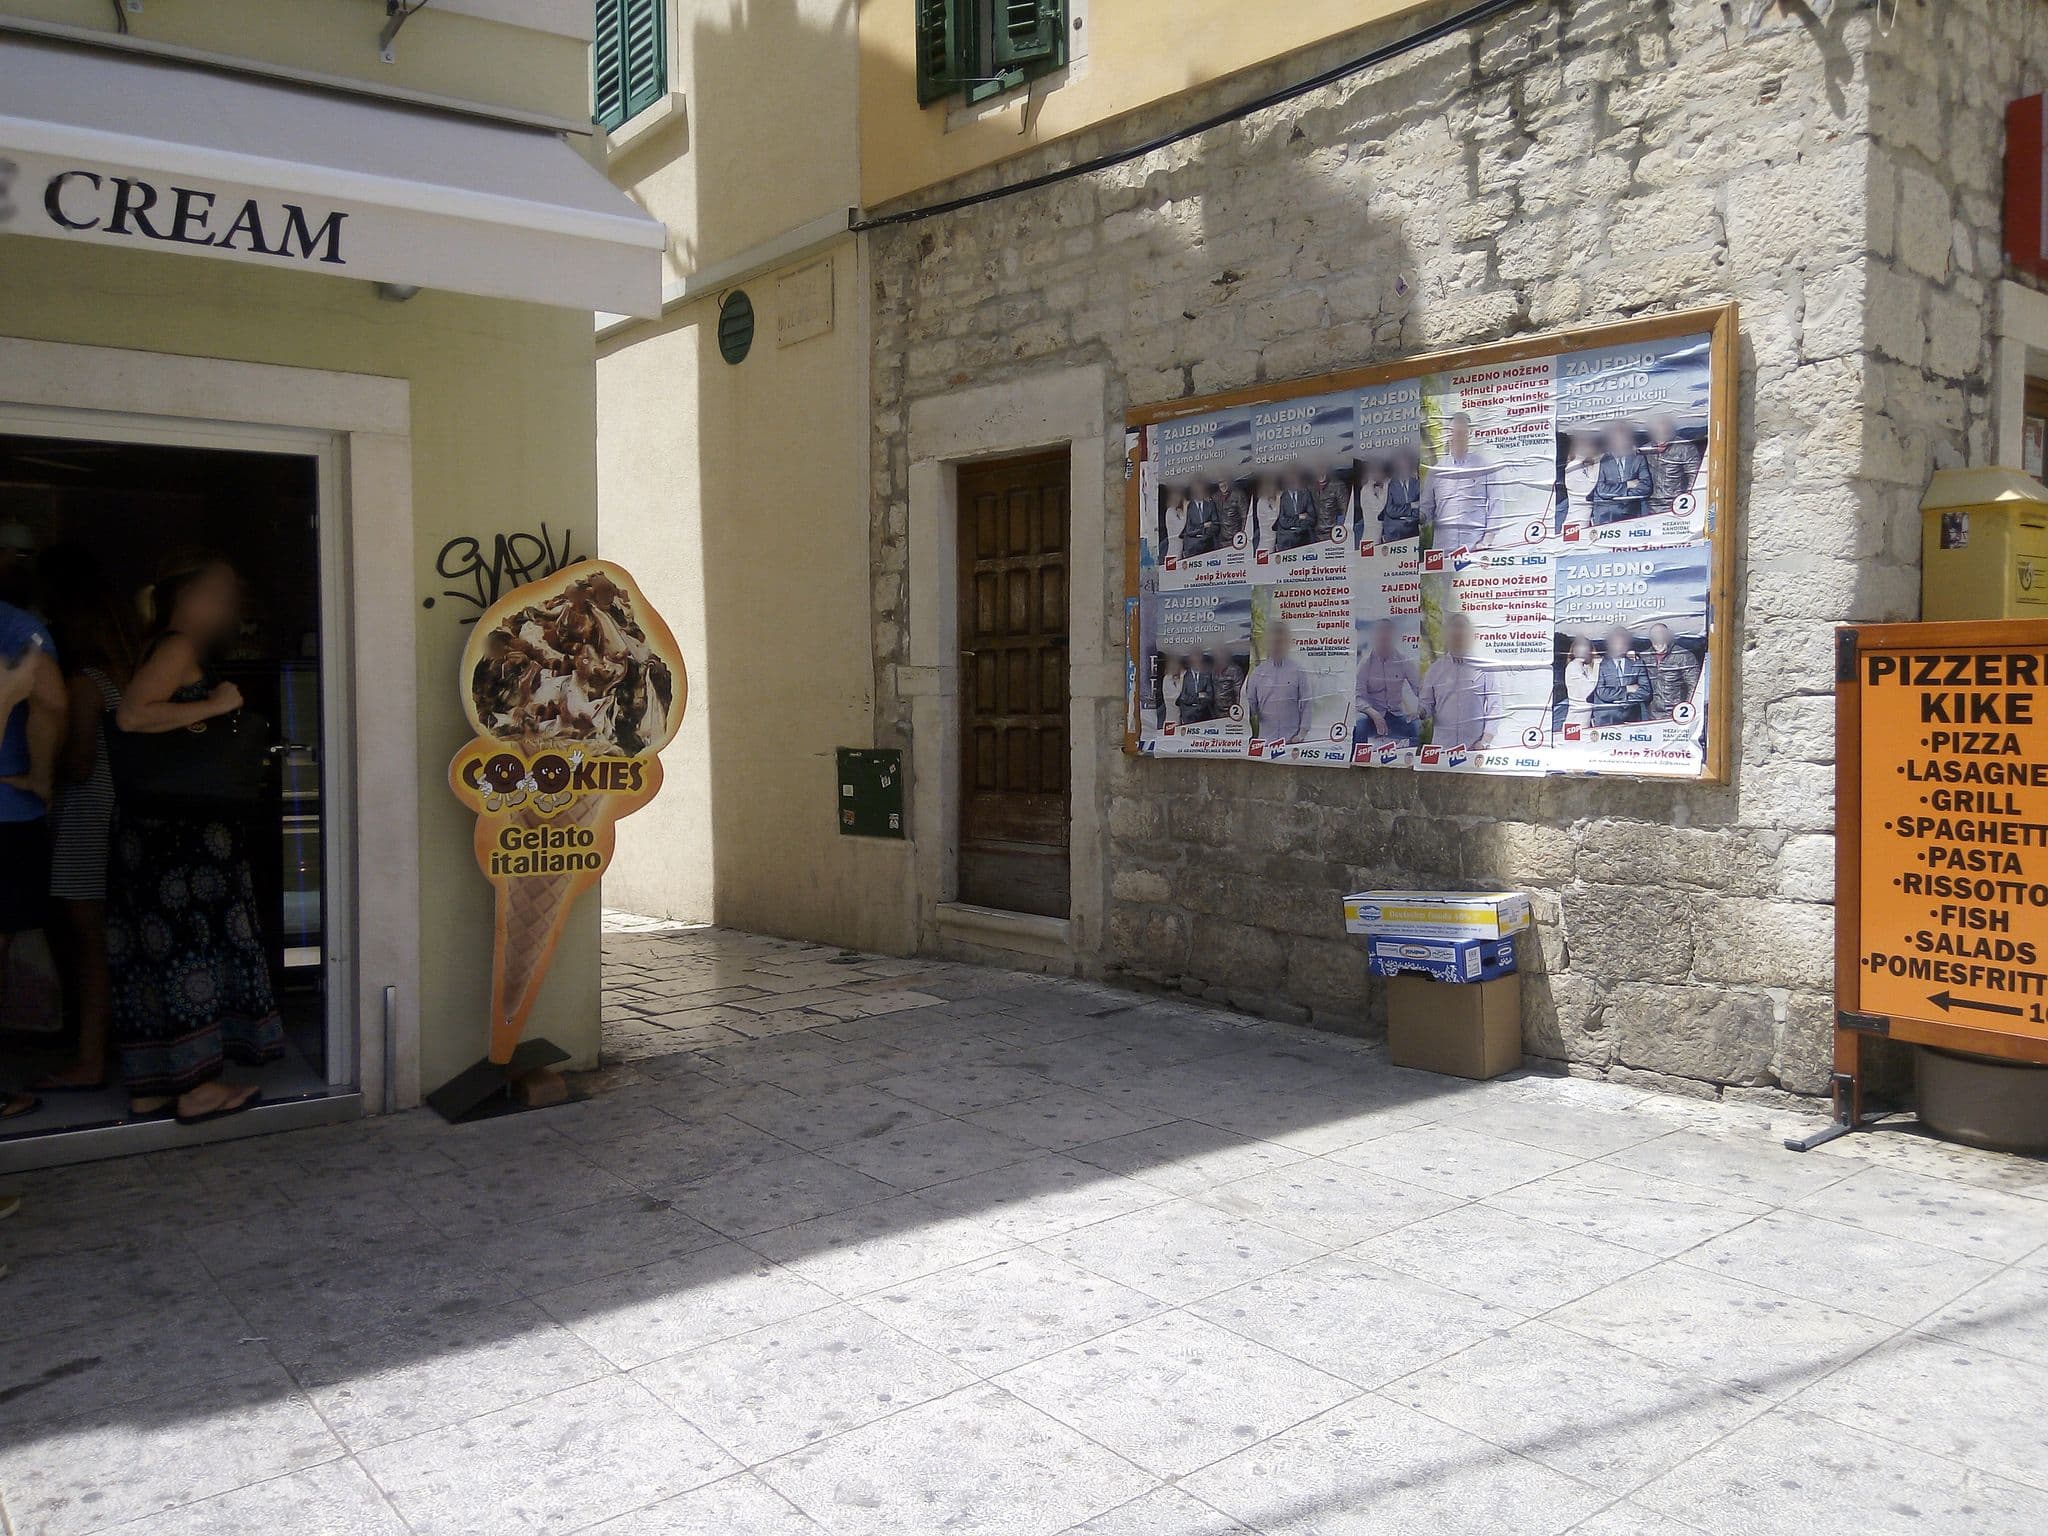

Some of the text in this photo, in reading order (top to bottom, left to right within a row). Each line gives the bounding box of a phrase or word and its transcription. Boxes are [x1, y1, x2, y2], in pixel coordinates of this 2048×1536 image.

[44, 170, 349, 265] CREAM
[1565, 353, 1656, 376] ZAJEDNO
[1452, 364, 1549, 385] ZAJEDNO MOŽEMO
[1460, 384, 1494, 396] skinuti
[1496, 379, 1536, 394] paučinu
[1565, 387, 1667, 411] jer smo drukčiji
[1507, 403, 1550, 416] županije
[1255, 406, 1316, 426] ZAJEDNO
[1163, 422, 1218, 440] ZAJEDNO
[1256, 423, 1312, 442] MOŽEMO
[1360, 429, 1373, 440] jer
[1376, 427, 1398, 436] smo
[1474, 421, 1550, 438] Franko Vidović
[1164, 437, 1216, 455] MOŽEMO
[1256, 435, 1324, 454] jer smo drukčiji
[1360, 435, 1410, 449] od drugih
[1177, 456, 1194, 465] smo
[1256, 451, 1298, 464] od drugih
[1165, 467, 1175, 476] od
[1679, 498, 1688, 509] 2
[1335, 528, 1343, 538] 2
[1600, 530, 1621, 539] HSS
[1236, 535, 1244, 545] 2
[1389, 545, 1408, 554] HSS
[1188, 560, 1203, 569] HSS
[1282, 554, 1298, 563] HSS
[1491, 556, 1515, 566] HSS
[1194, 570, 1247, 581] Josip Živković
[1289, 565, 1347, 577] Josip Živković
[1567, 561, 1655, 580] ZAJEDNO
[1452, 574, 1548, 588] ZAJEDNO MOŽEMO
[1274, 586, 1350, 598] ZAJEDNO MOŽEMO
[1460, 590, 1493, 600] skinuti
[1495, 589, 1534, 599] paučinu
[1566, 579, 1649, 598] MOŽEMO
[1164, 597, 1219, 609] ZAJEDNO
[1280, 600, 1307, 609] skinuti
[1308, 599, 1339, 609] paučinu
[1388, 595, 1419, 604] skinuti
[1565, 596, 1665, 613] jer smo drukčiji
[1461, 601, 1548, 611] Šibensko-kninske
[1164, 609, 1215, 624] MOŽEMO
[1281, 609, 1350, 619] Šibensko-kninske
[1506, 613, 1547, 623] županije
[1163, 627, 1175, 636] jer
[1175, 626, 1192, 634] smo
[1316, 620, 1350, 630] županije
[1175, 635, 1202, 645] drugih
[1319, 636, 1350, 645] Vidović
[1474, 631, 1547, 640] Franko Vidović
[1232, 707, 1240, 716] 2
[1679, 706, 1689, 718] 2
[1920, 692, 2033, 725] KIKE
[1186, 727, 1201, 735] HSS
[1335, 726, 1343, 737] 2
[1528, 731, 1537, 742] 2
[1600, 731, 1622, 741] HSS
[1190, 738, 1243, 749] Josip Živković
[1931, 731, 2022, 756] PIZZA
[1300, 750, 1321, 758] HSS
[1643, 747, 1692, 759] Živković
[1485, 756, 1509, 766] HSS
[462, 753, 643, 794] COOKIES
[1907, 759, 2048, 787] LASAGNE
[1931, 789, 2022, 816] GRILL
[500, 827, 594, 851] Gelato
[491, 850, 602, 875] italiano
[1928, 846, 2023, 875] PASTA
[1903, 872, 2048, 907] RISSOTTO
[1940, 904, 2009, 933] FISH
[1915, 930, 2037, 965] SALADS
